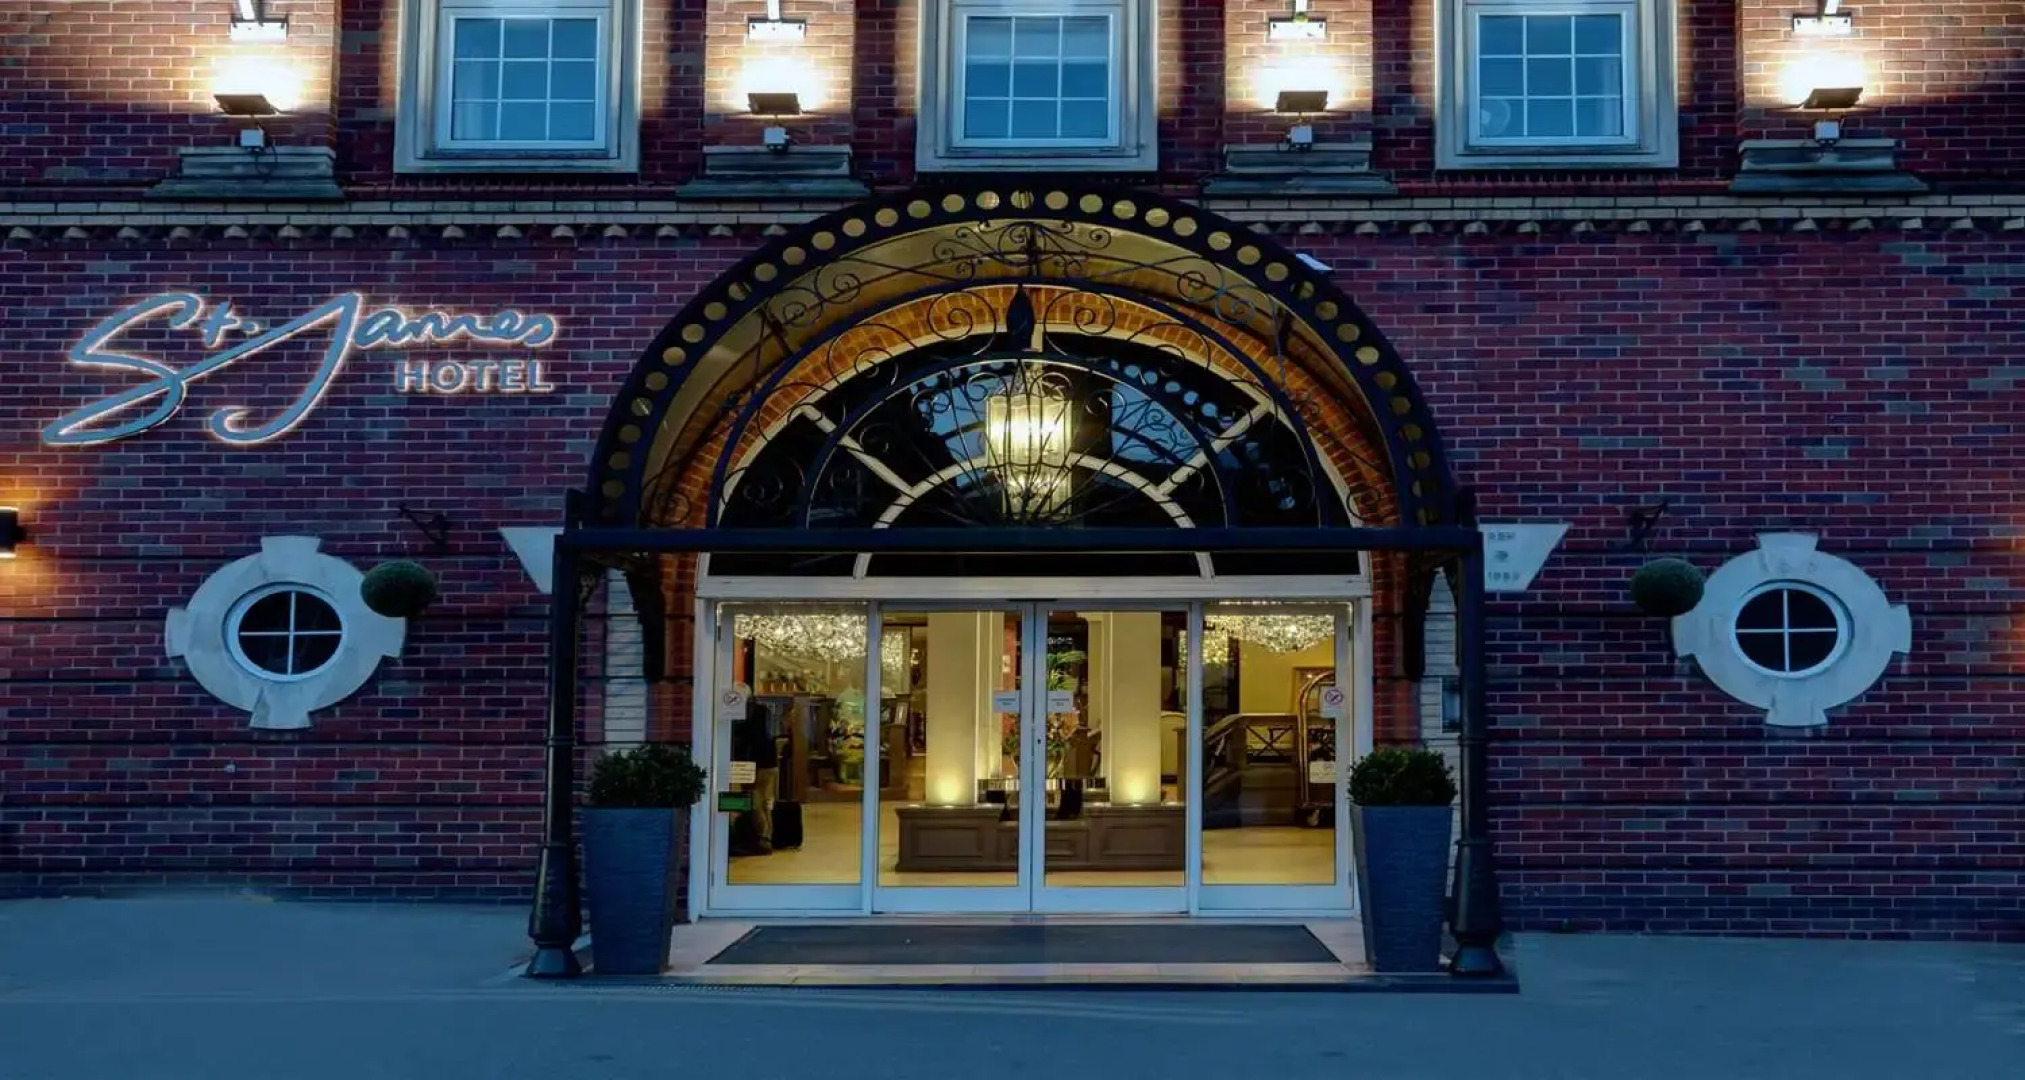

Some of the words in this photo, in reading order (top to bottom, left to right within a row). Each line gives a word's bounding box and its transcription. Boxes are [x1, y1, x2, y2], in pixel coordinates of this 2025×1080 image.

[43, 292, 260, 445] St.
[209, 291, 556, 444] James
[395, 360, 555, 393] HOTEL
